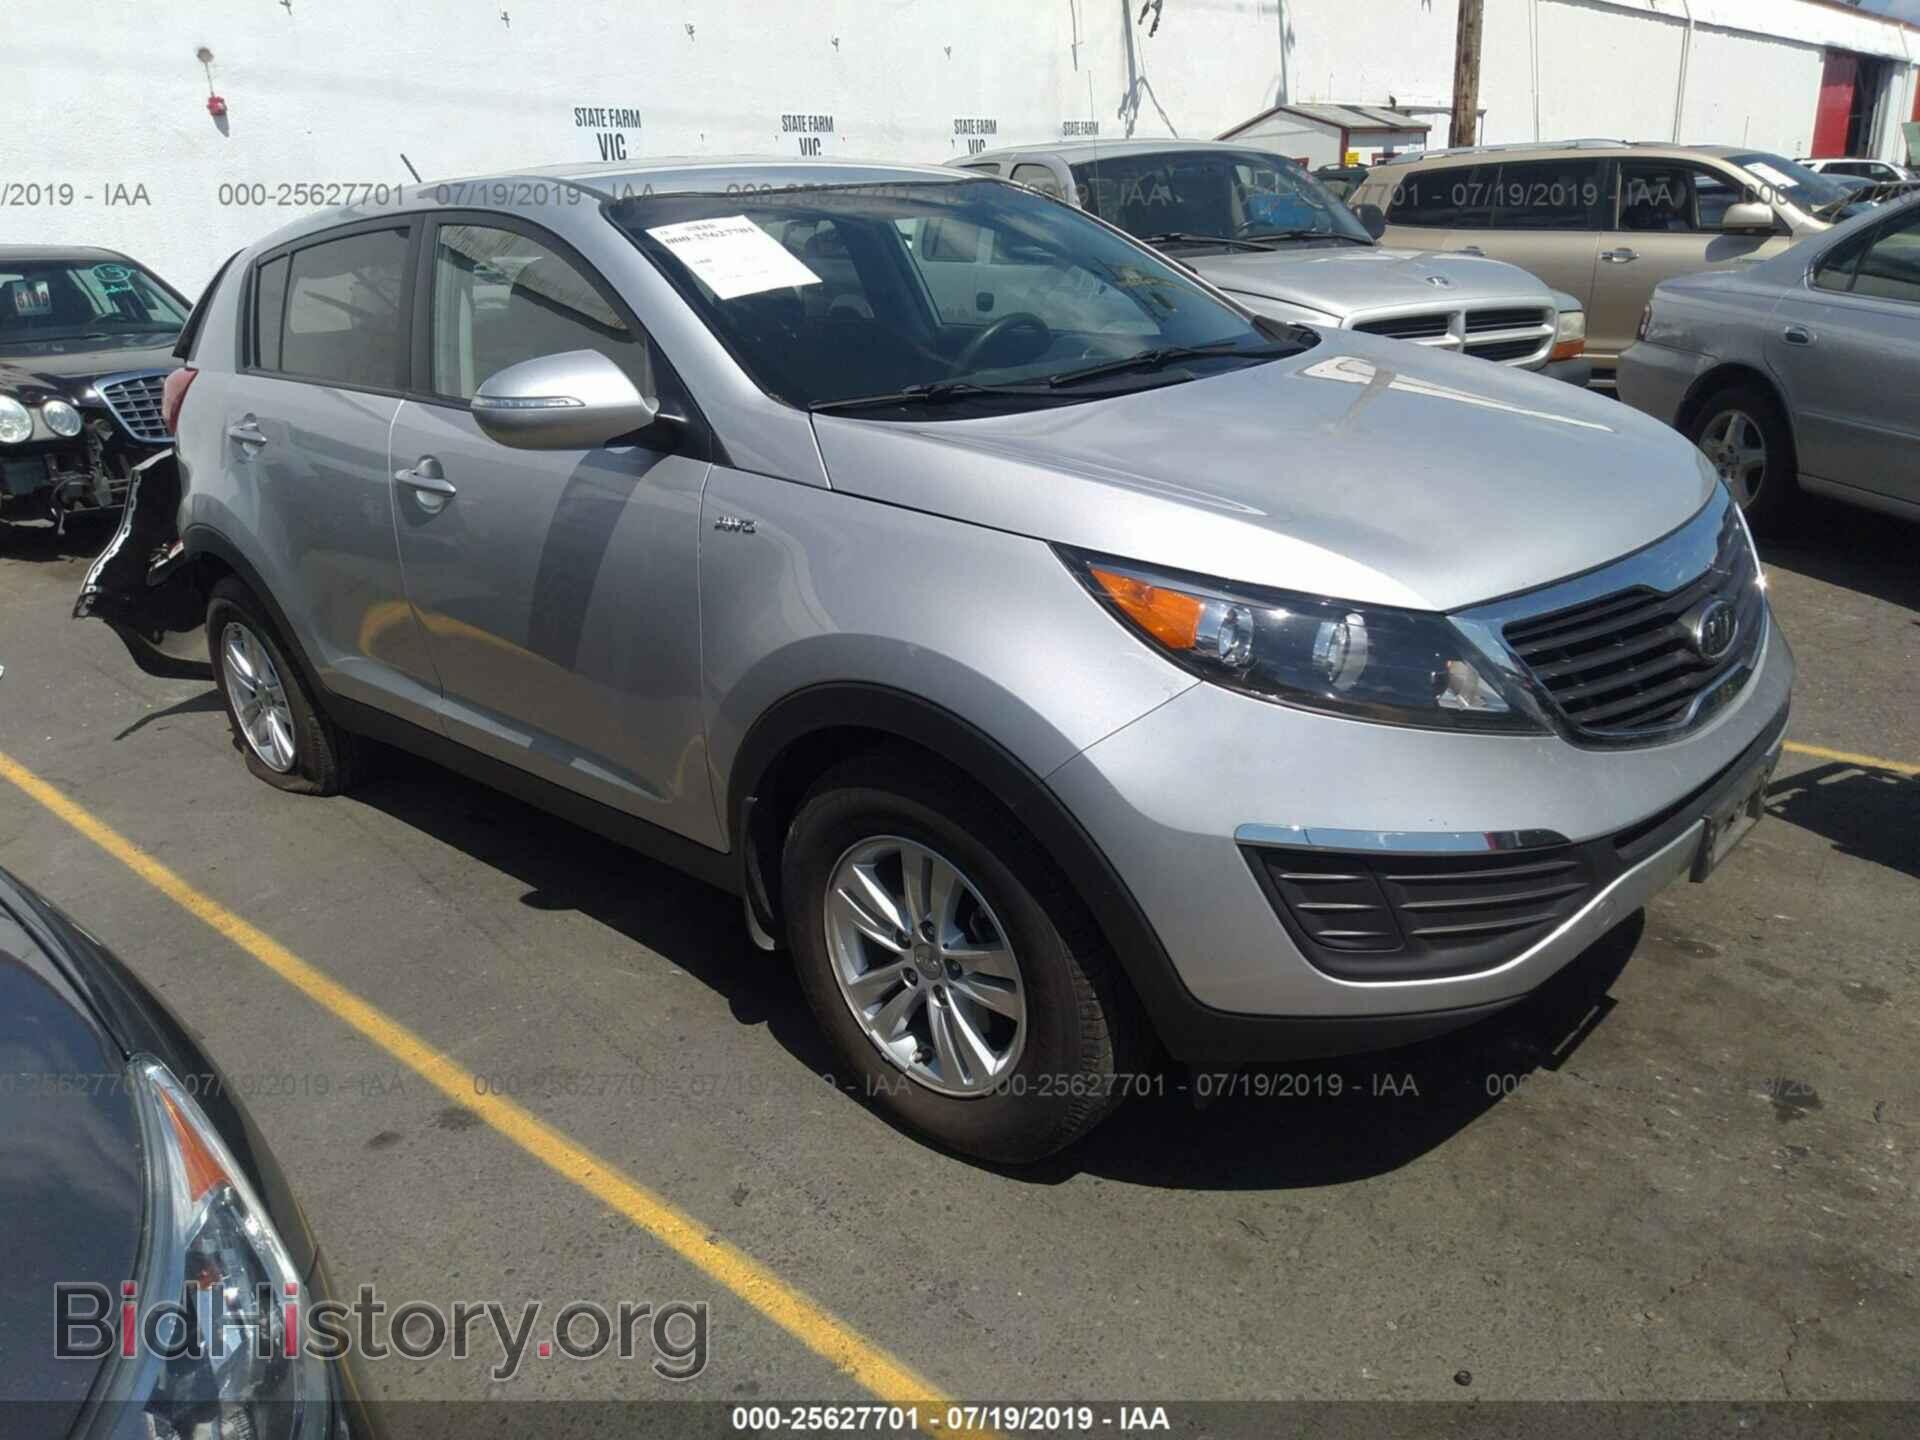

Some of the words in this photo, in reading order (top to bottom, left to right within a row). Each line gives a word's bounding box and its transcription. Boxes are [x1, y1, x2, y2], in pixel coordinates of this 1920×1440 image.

[574, 107, 608, 128] STATE
[609, 109, 642, 129] FARM
[781, 115, 807, 133] STATE
[808, 115, 834, 133] FARM
[954, 119, 976, 135] STATE
[976, 119, 998, 135] FARM
[1062, 121, 1081, 136] STATE
[1081, 121, 1099, 136] FARM
[597, 133, 627, 161] VIC
[798, 137, 822, 156] VIC
[968, 139, 987, 154] VIC
